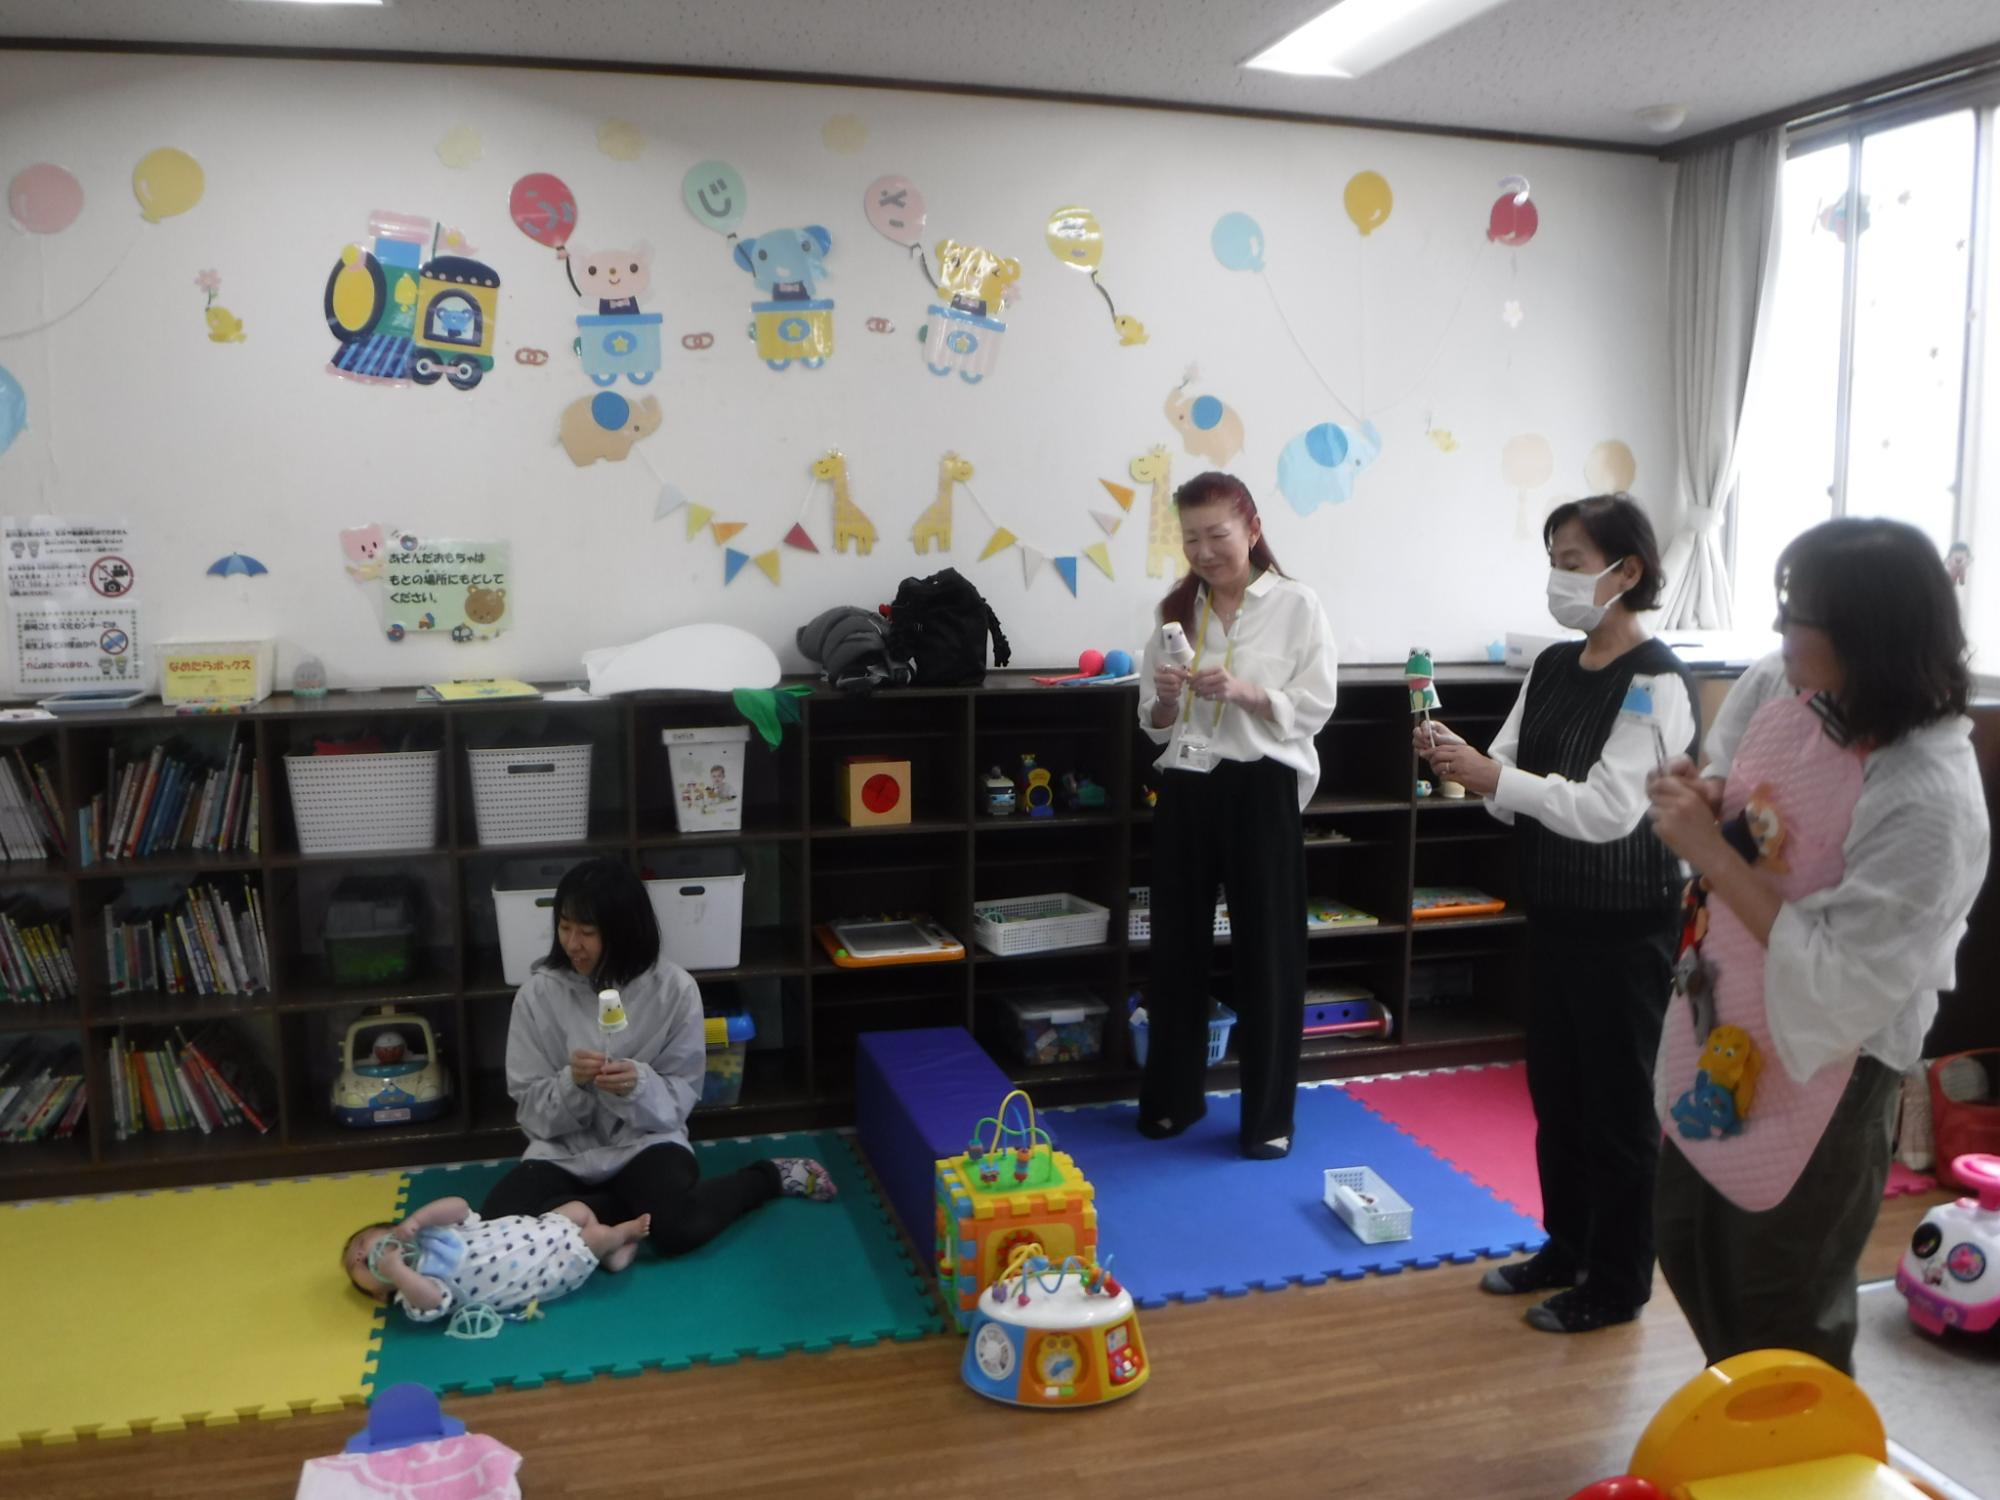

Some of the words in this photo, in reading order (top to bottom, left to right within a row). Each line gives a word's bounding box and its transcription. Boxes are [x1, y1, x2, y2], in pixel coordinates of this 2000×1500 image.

[388, 551, 486, 564] あそんだおもちゃは
[388, 573, 504, 586] もとの場所にもどして
[389, 592, 438, 604] ください。
